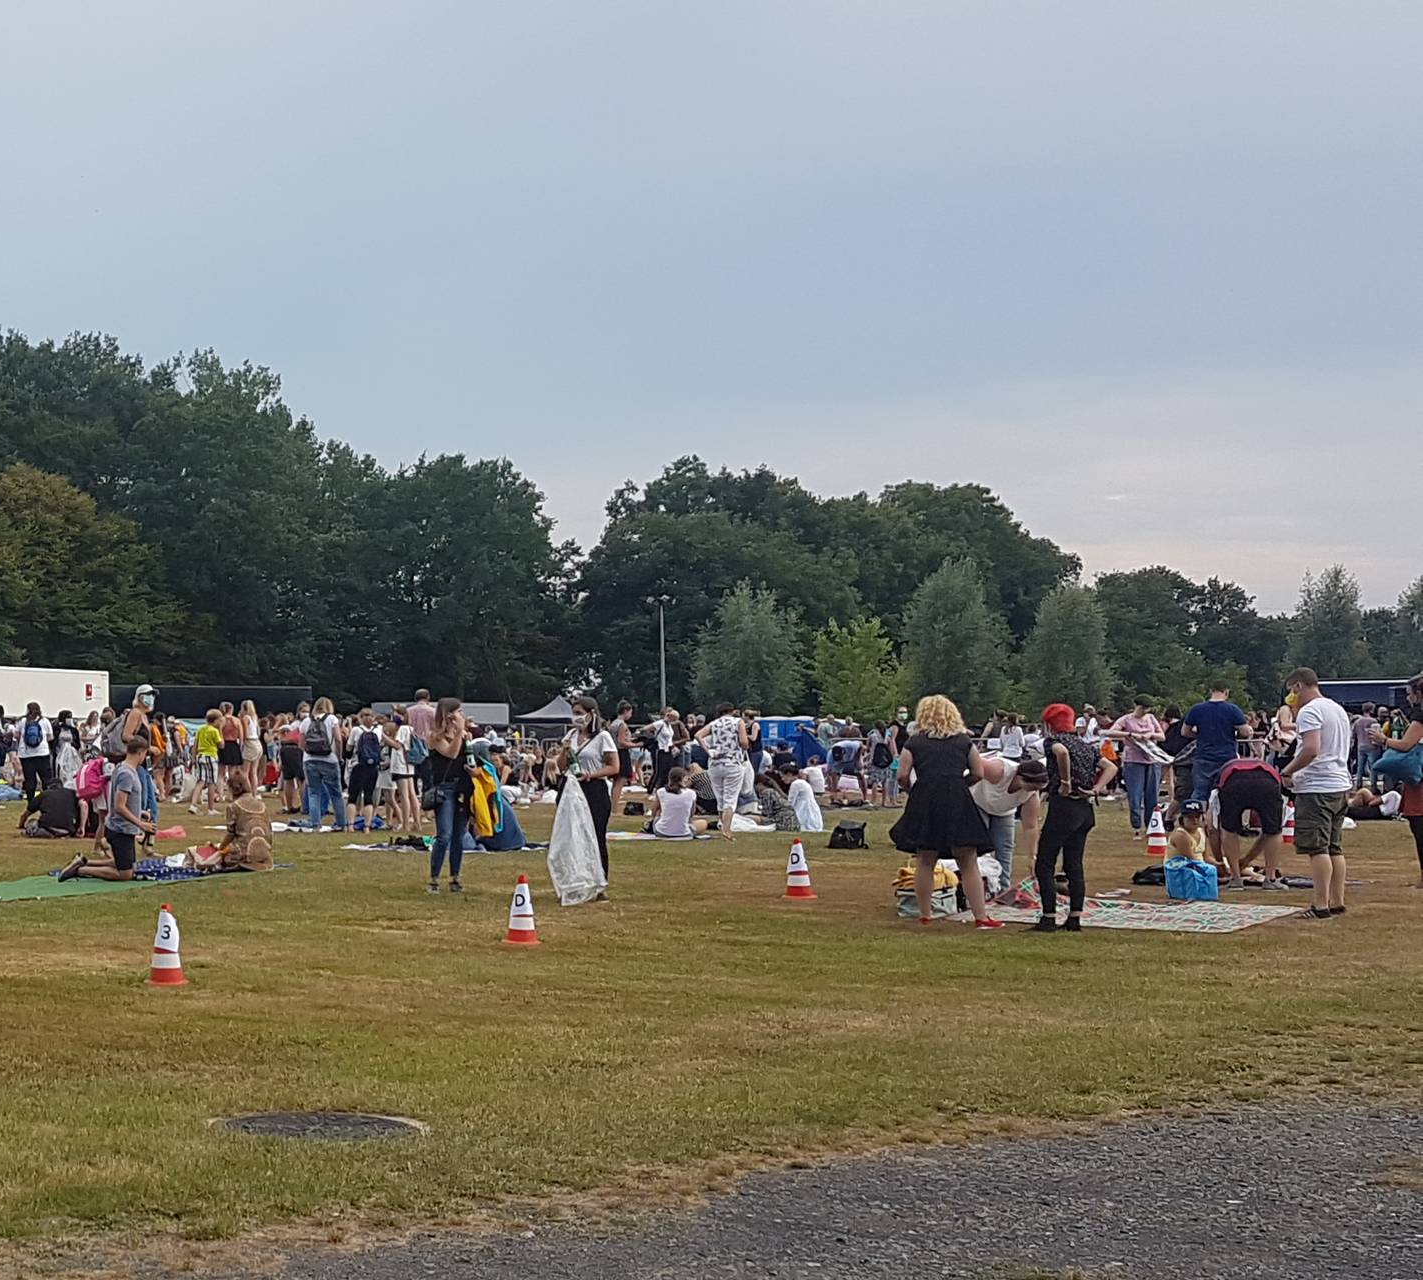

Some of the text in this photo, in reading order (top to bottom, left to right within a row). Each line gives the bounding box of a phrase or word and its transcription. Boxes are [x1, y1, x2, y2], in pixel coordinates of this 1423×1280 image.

[791, 853, 800, 864] D
[515, 894, 525, 907] D
[161, 925, 171, 940] 3
